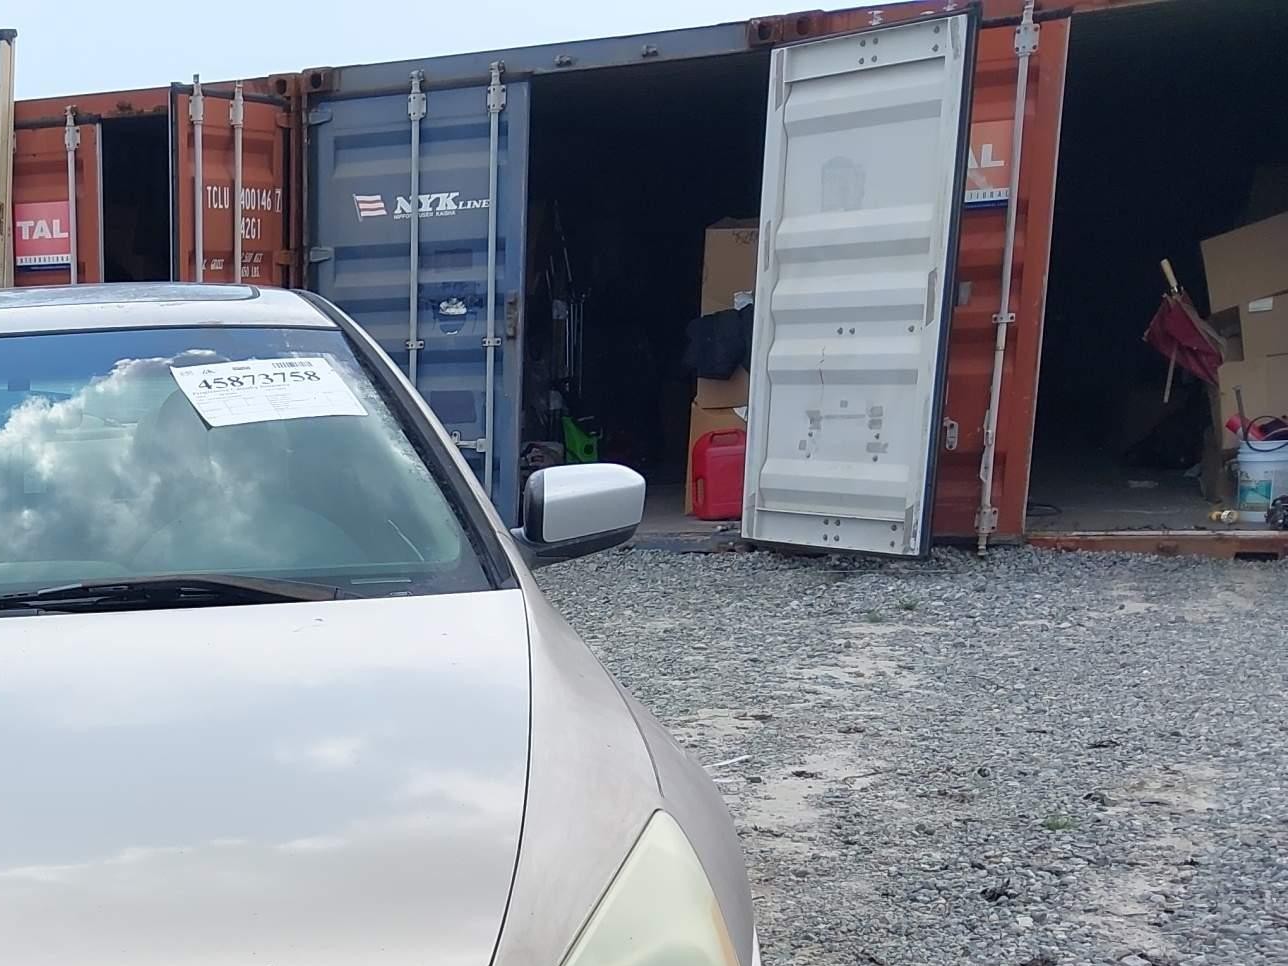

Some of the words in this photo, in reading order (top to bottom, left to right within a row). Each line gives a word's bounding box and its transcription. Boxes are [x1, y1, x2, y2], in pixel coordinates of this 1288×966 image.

[206, 186, 230, 209] TCLU
[394, 191, 460, 214] NYK
[458, 199, 490, 210] LINE
[16, 219, 69, 240] TAL
[198, 370, 321, 390] 45873758
